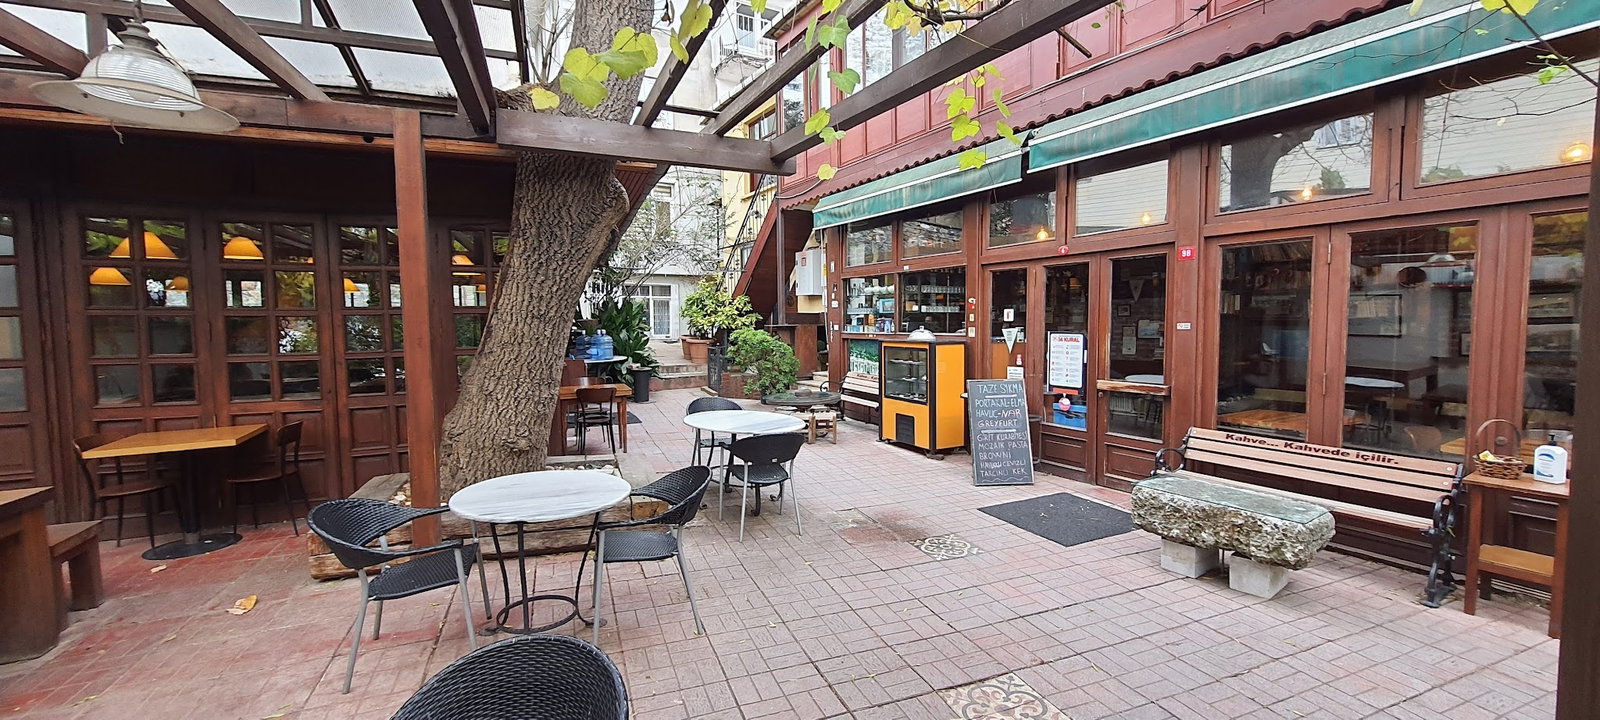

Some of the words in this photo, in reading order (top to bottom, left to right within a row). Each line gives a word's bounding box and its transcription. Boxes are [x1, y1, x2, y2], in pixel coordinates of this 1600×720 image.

[1181, 249, 1192, 257] 98
[976, 384, 997, 394] TAZE
[978, 419, 1018, 427] GREYFURT
[1008, 441, 1028, 450] PASTA
[1226, 434, 1278, 446] Kahve...
[1284, 442, 1350, 458] Kahvede
[1356, 452, 1398, 464] içilir.
